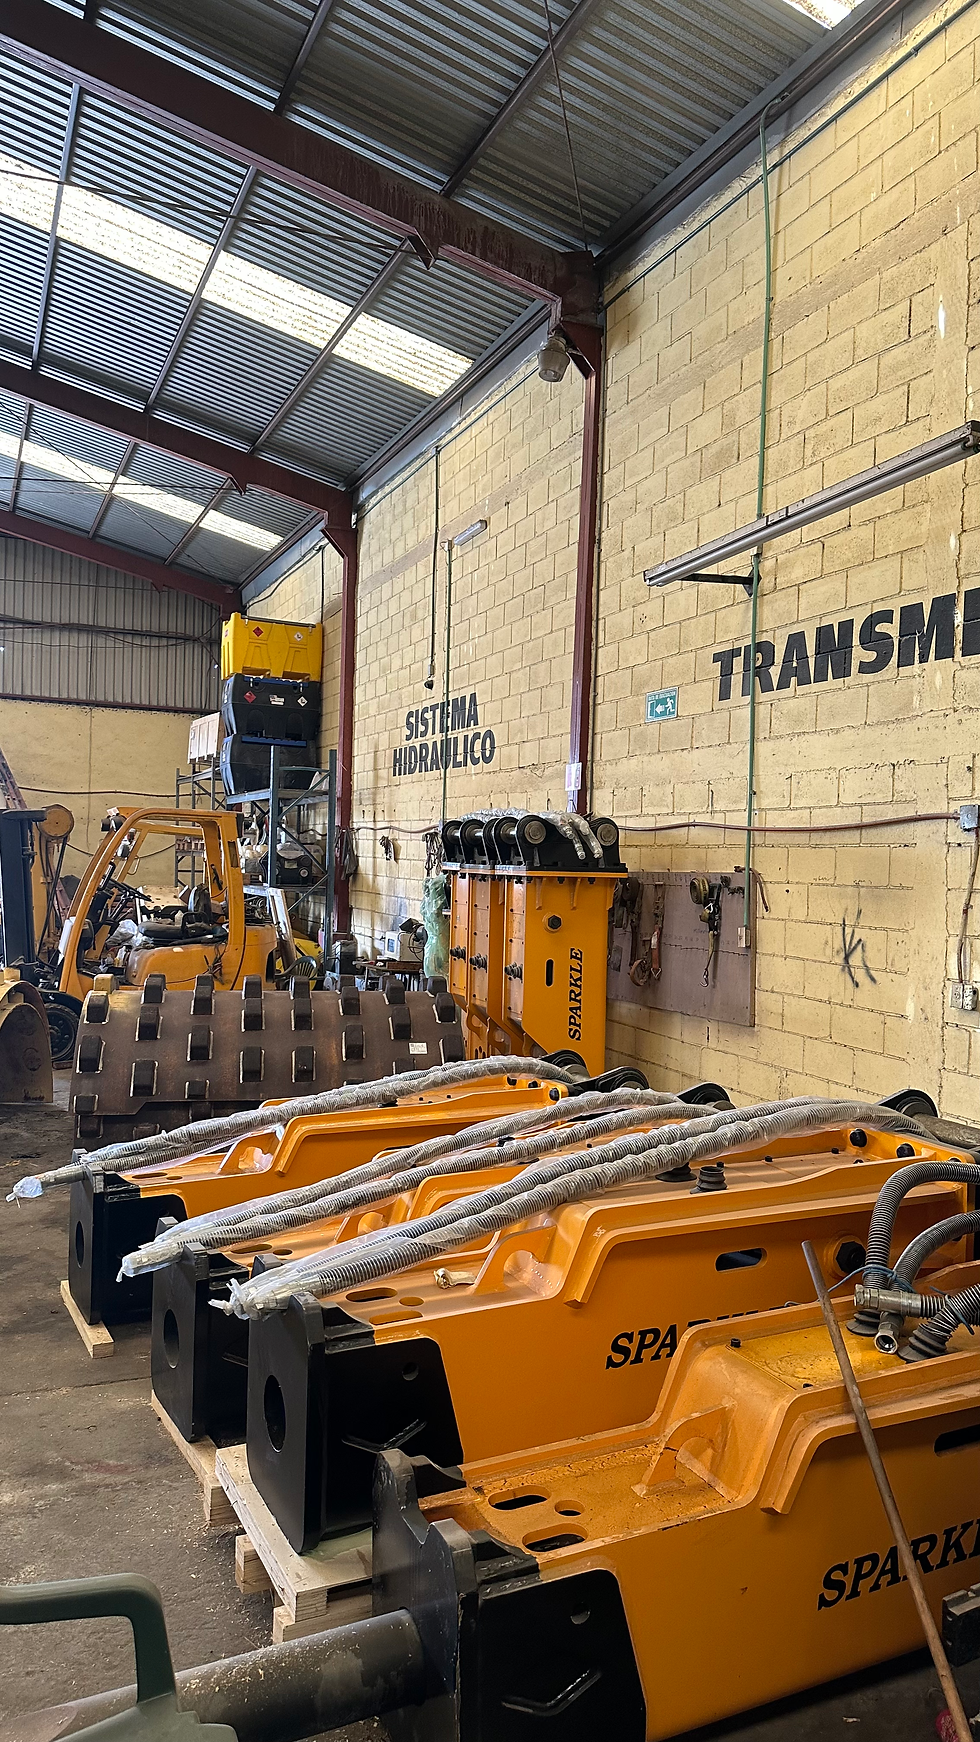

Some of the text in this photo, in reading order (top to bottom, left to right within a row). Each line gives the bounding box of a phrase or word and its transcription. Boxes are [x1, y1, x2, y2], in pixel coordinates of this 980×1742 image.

[405, 692, 479, 742] SISTEMA
[392, 729, 496, 777] HIDRAULICO
[568, 947, 584, 1042] SPARKLE
